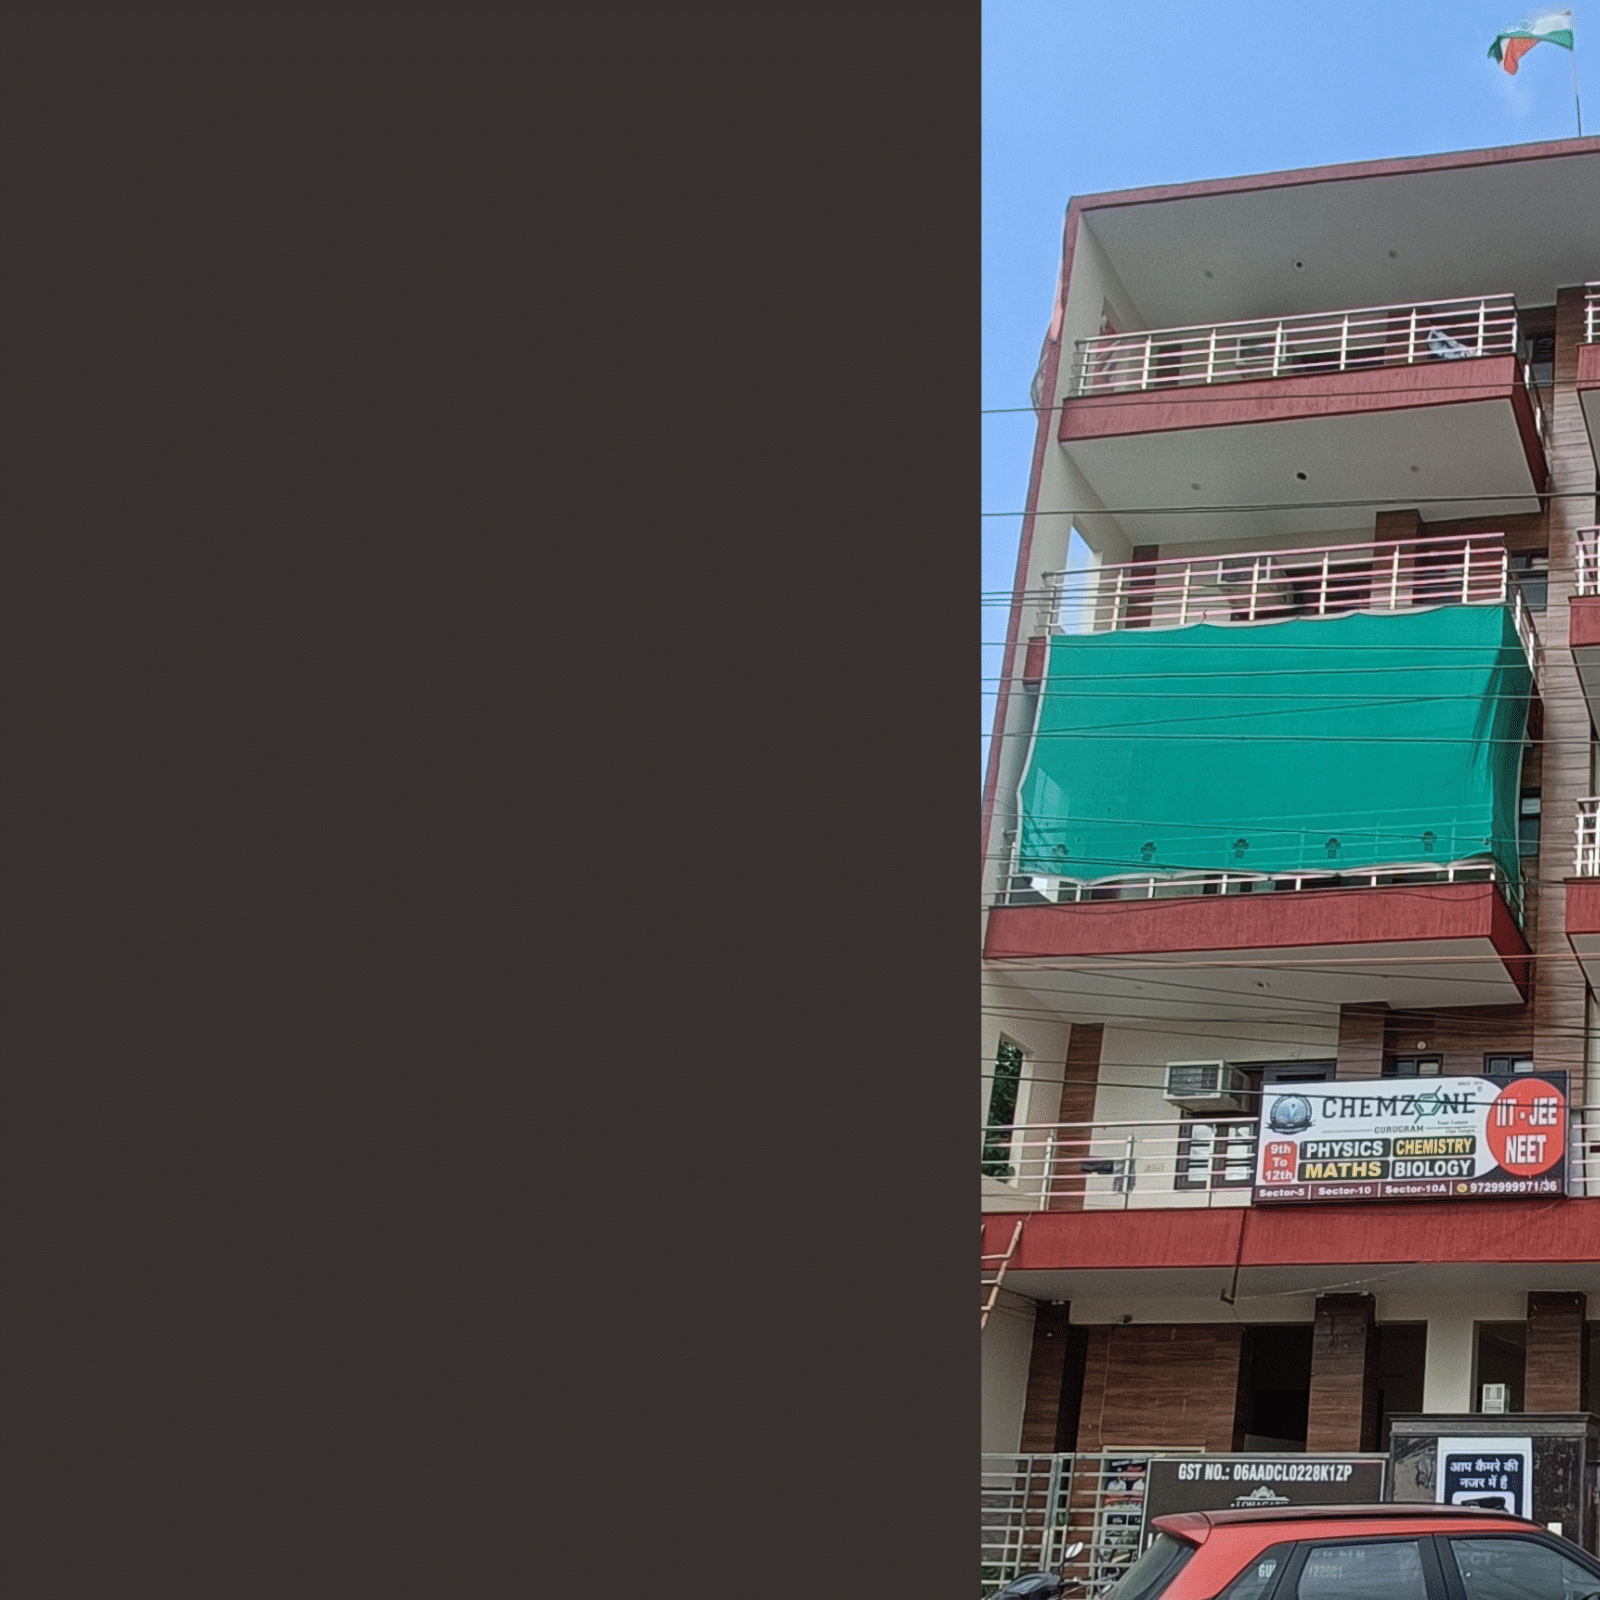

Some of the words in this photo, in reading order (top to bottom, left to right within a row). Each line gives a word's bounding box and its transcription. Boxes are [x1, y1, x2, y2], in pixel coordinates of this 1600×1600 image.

[1529, 1097, 1558, 1126] JEE
[1374, 1126, 1424, 1134] GURUGRAM
[1270, 1143, 1292, 1155] 9th
[1306, 1141, 1384, 1158] PHYSICS
[1396, 1138, 1473, 1155] CHEMISTRY
[1506, 1134, 1547, 1164] NEET
[1272, 1157, 1288, 1167] To
[1394, 1160, 1472, 1177] BIOLOGY
[1265, 1170, 1294, 1181] 12th
[1305, 1162, 1382, 1178] MATHS
[1259, 1188, 1305, 1198] Sector-5
[1318, 1186, 1372, 1196] Sector-10
[1385, 1184, 1447, 1194] Sector-10A
[1178, 1463, 1202, 1480] GST
[1204, 1464, 1230, 1481] NO.:
[1450, 1461, 1473, 1472] आप
[1475, 1457, 1501, 1472] कैमरे
[1503, 1458, 1519, 1472] की
[1459, 1478, 1485, 1488] नजर
[1487, 1474, 1498, 1488] में
[1499, 1474, 1508, 1489] है
